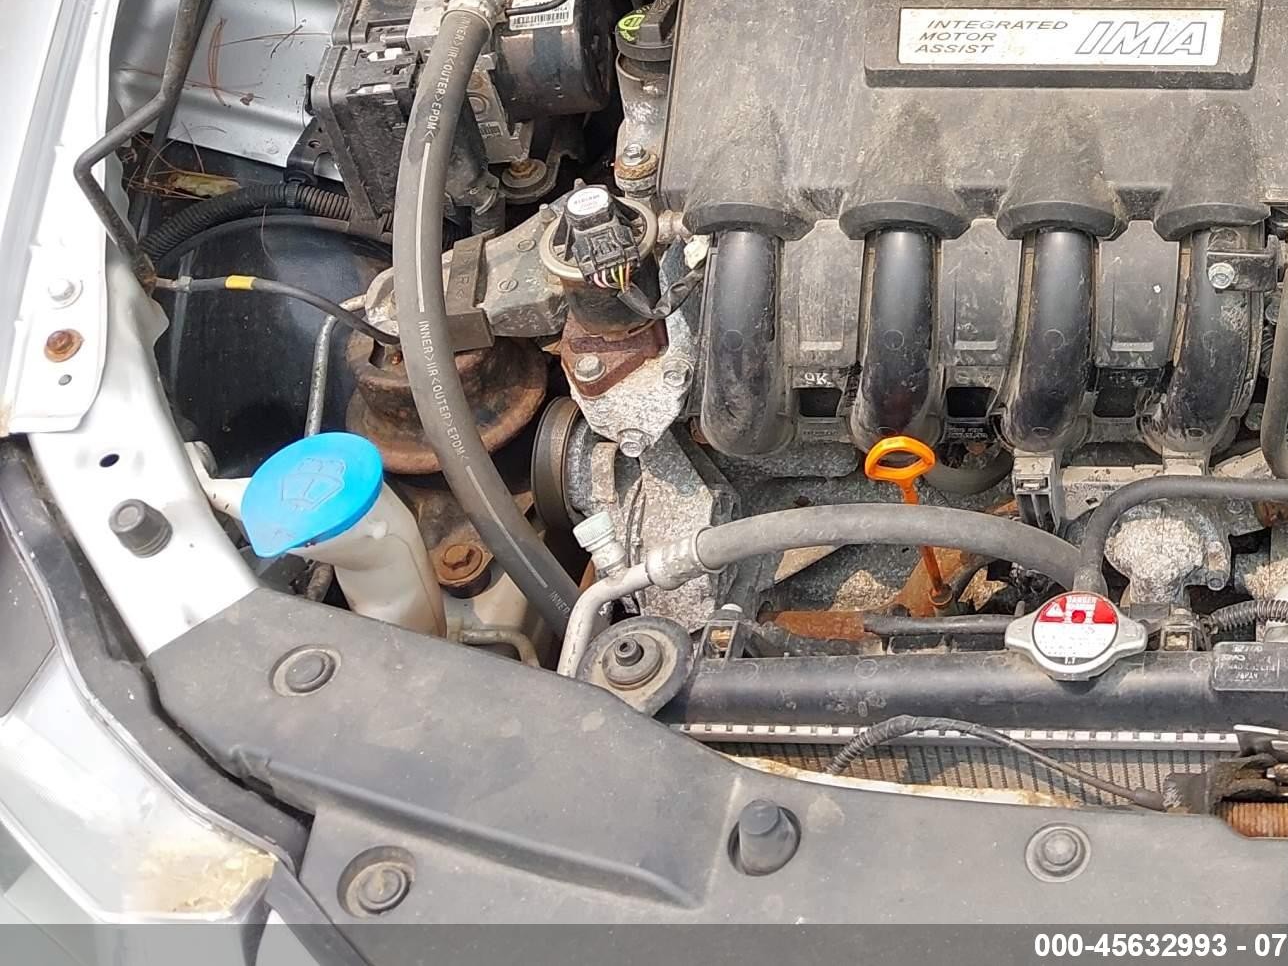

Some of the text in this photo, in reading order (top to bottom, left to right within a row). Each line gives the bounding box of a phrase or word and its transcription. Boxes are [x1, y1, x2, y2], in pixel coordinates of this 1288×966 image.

[928, 20, 1068, 30] INTEGRATED
[919, 32, 997, 42] MOTOR
[1075, 21, 1208, 56] IMA
[914, 44, 994, 54] ASSIST
